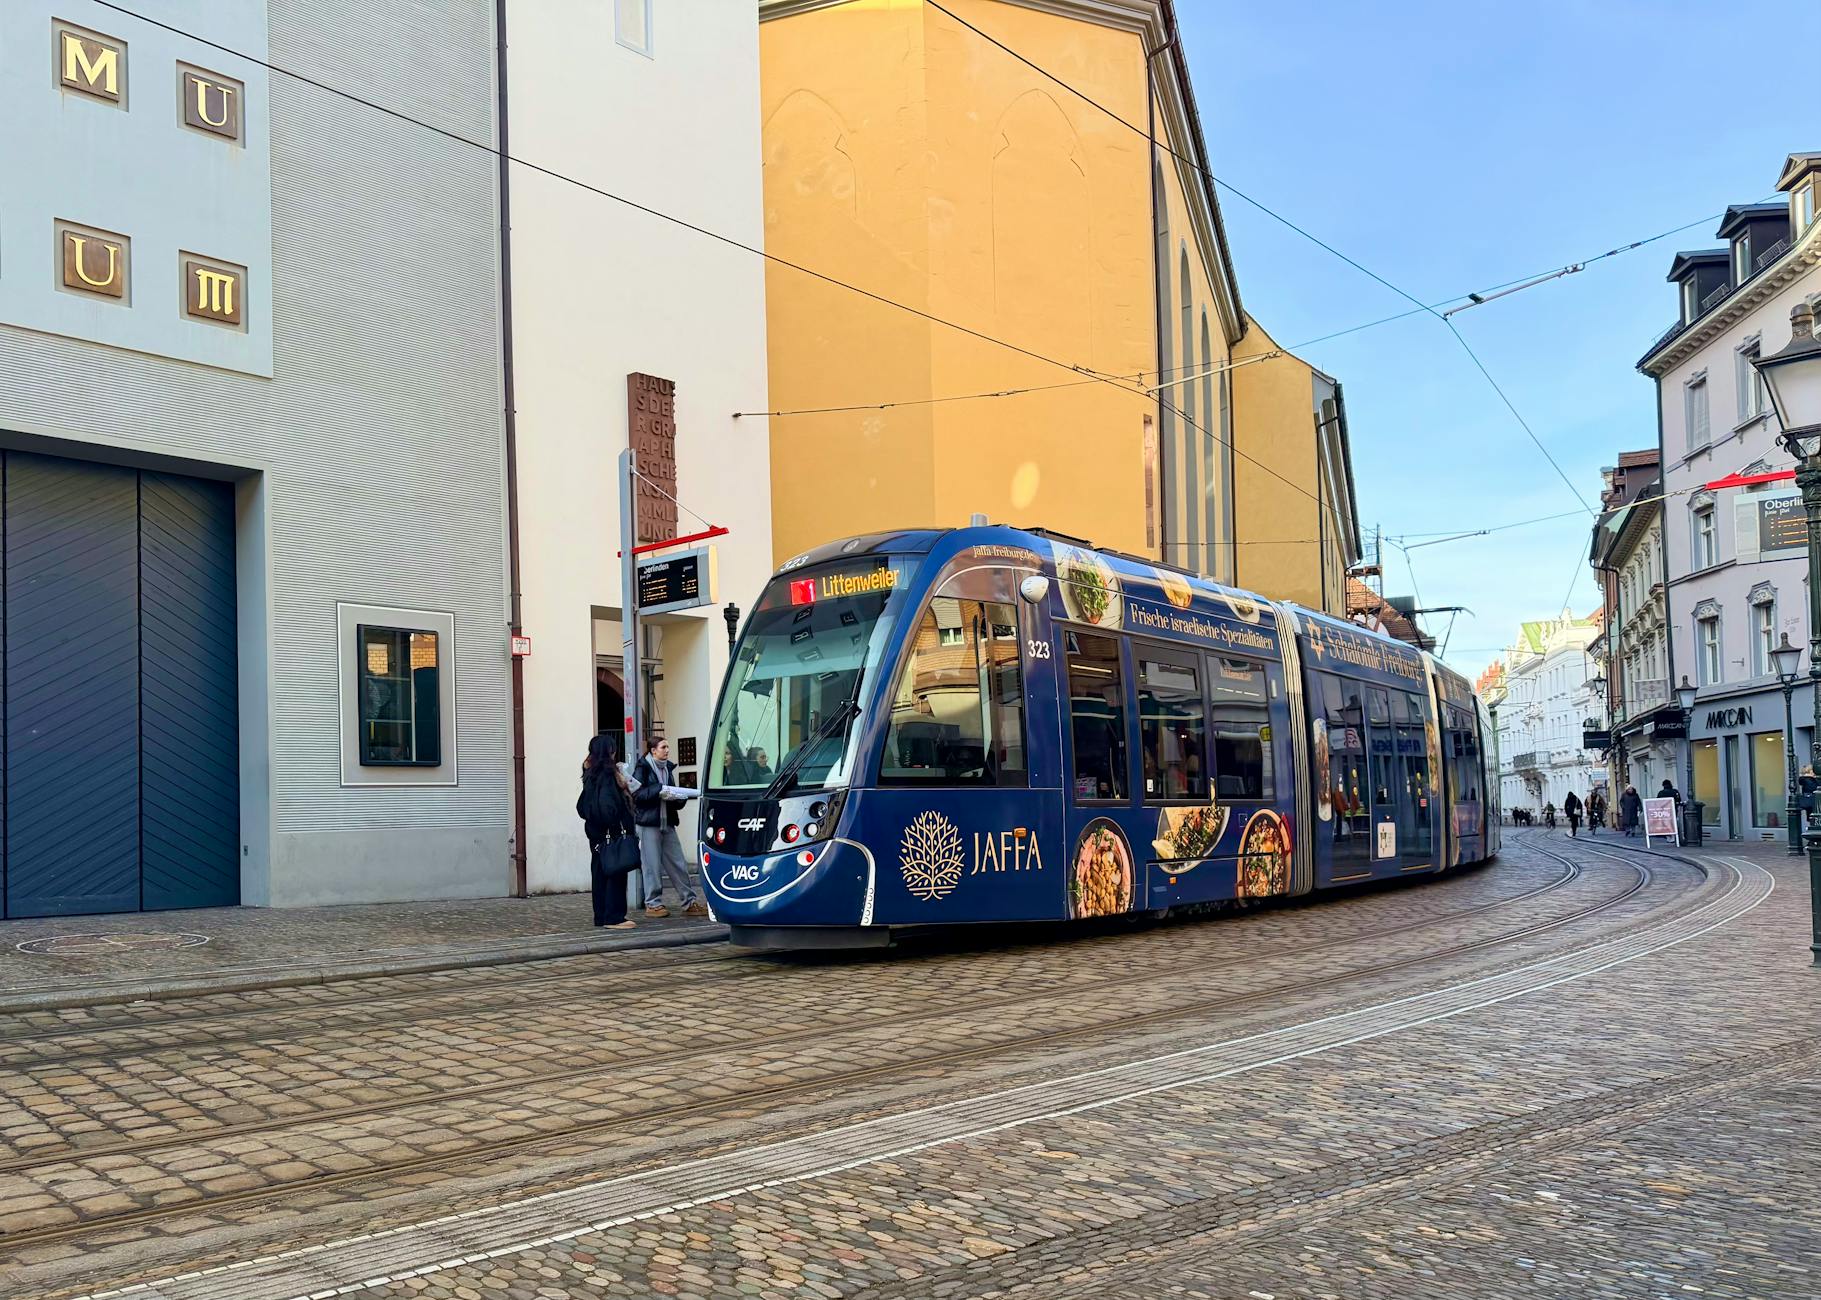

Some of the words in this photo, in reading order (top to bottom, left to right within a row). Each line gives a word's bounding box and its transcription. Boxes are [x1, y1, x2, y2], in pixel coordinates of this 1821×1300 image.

[64, 35, 119, 95] M
[191, 77, 232, 127] U
[69, 236, 118, 286] U
[1764, 497, 1804, 510] Oberli
[822, 568, 900, 597] Littenweiler
[1129, 602, 1170, 630] Frische
[1169, 613, 1220, 640] israelische
[1220, 622, 1275, 651] Spezialitäten
[1027, 639, 1051, 660] 323
[971, 829, 1043, 876] JAFFA
[731, 865, 760, 881] VAG
